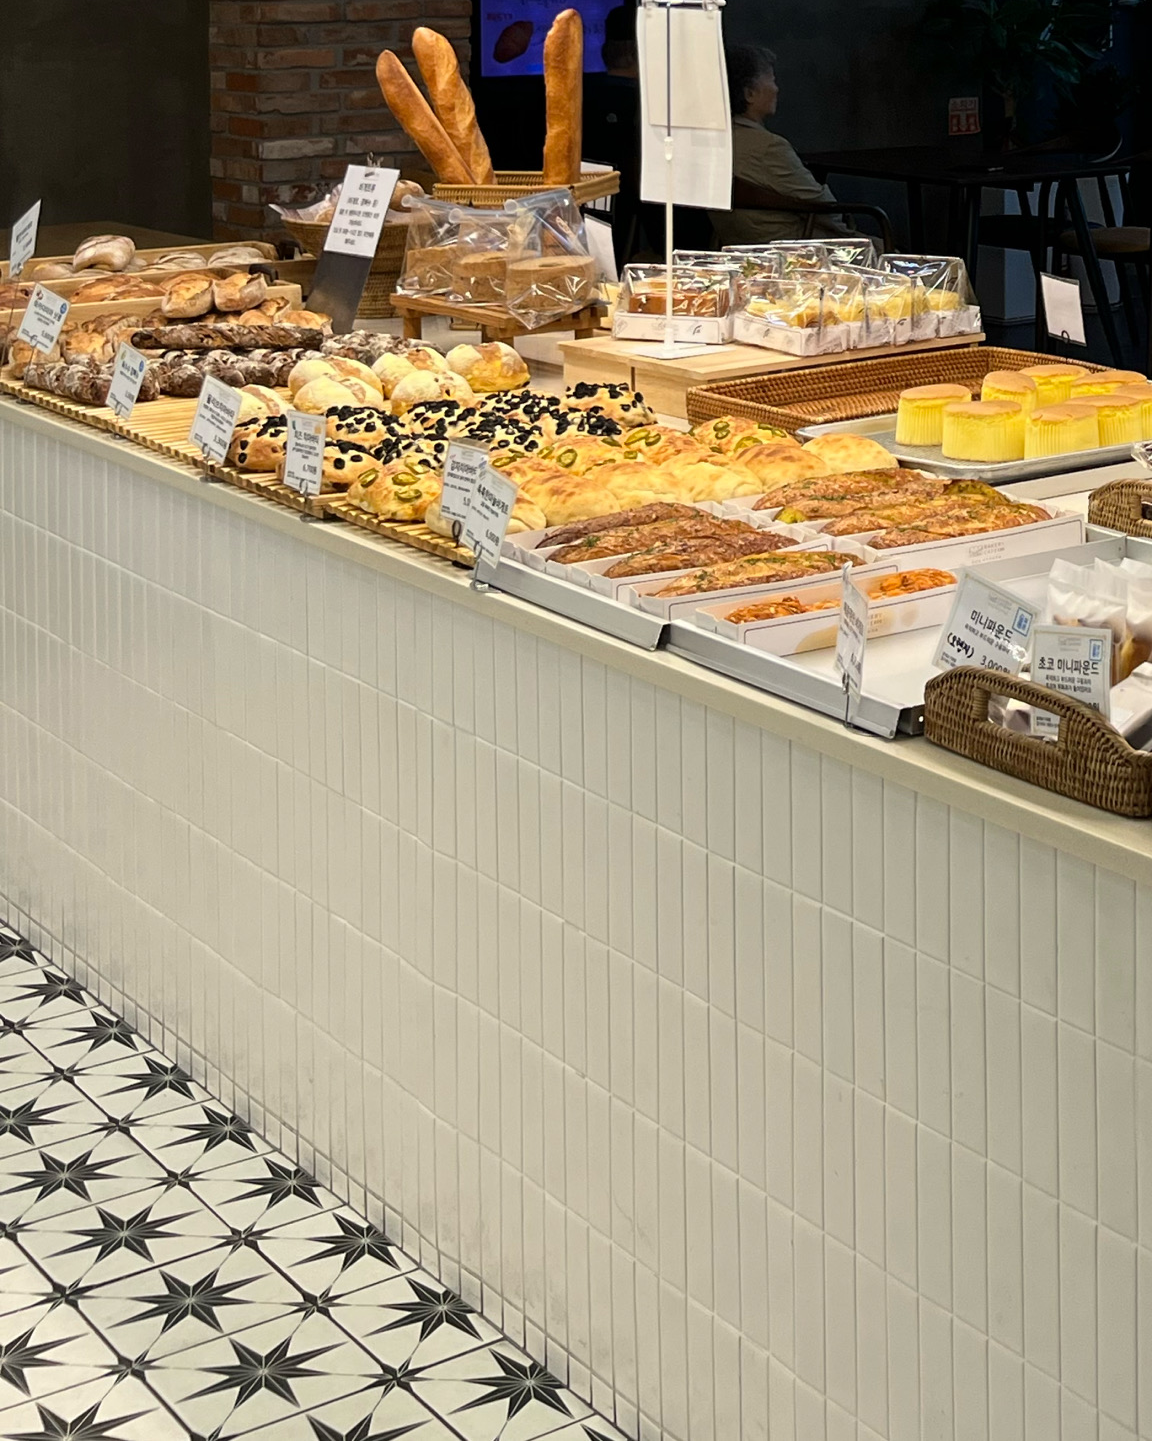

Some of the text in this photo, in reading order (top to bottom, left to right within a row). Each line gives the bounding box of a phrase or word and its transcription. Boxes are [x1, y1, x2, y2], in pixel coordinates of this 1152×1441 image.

[970, 609, 1013, 643] 미니파운드
[1038, 656, 1100, 676] 초코 미니파운드
